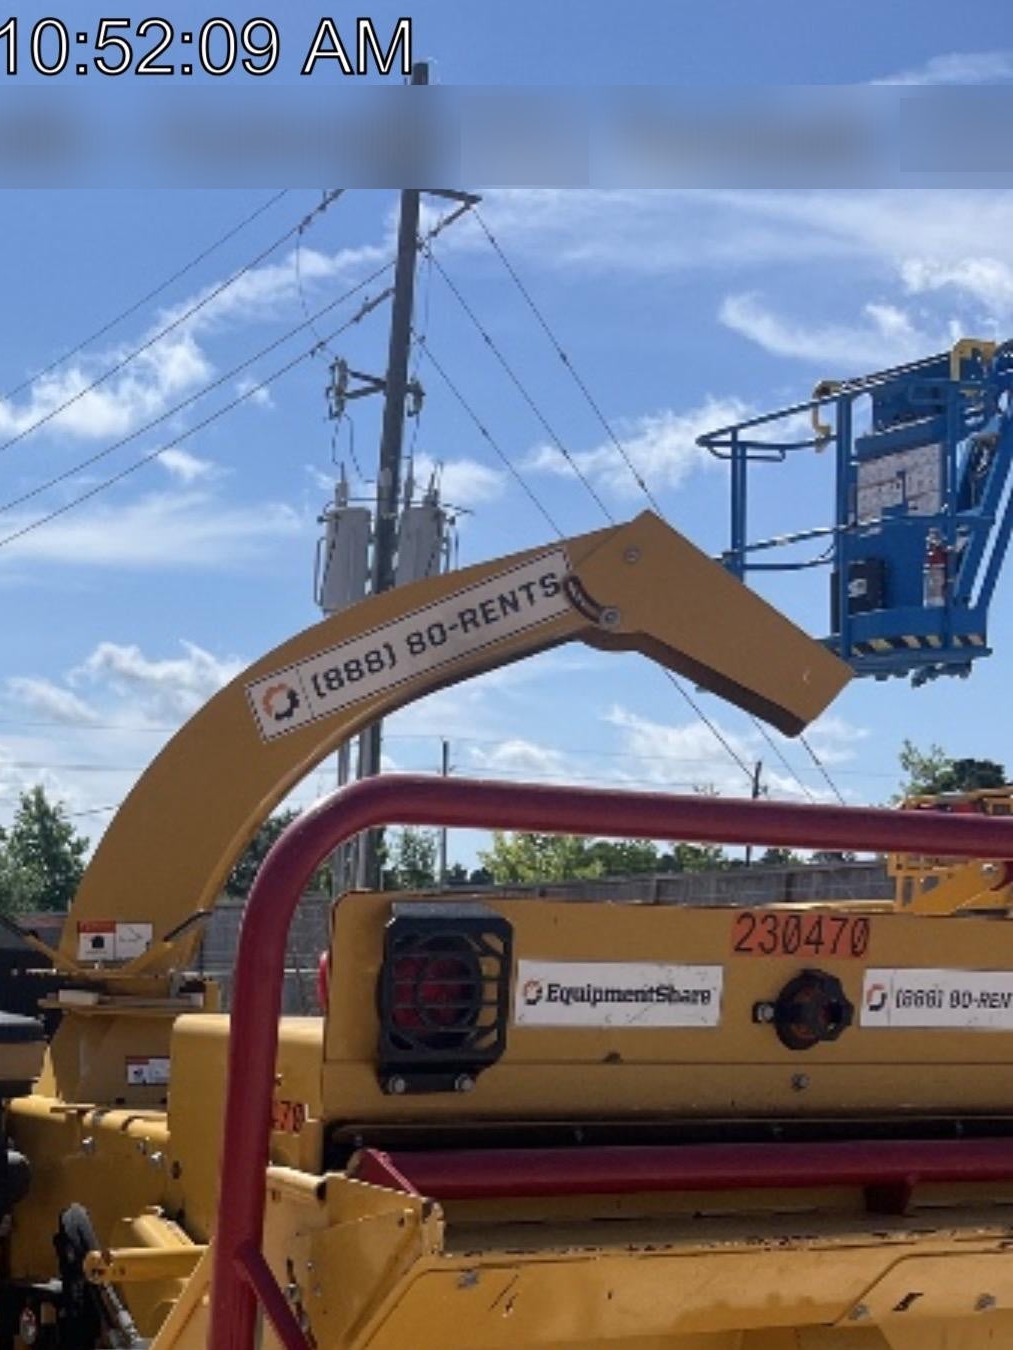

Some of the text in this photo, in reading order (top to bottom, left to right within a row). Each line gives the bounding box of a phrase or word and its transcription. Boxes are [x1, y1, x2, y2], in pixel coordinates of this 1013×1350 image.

[311, 571, 562, 699] (888) 80-RENTS
[734, 911, 870, 957] 230470
[546, 984, 712, 1007] EquipmentShare
